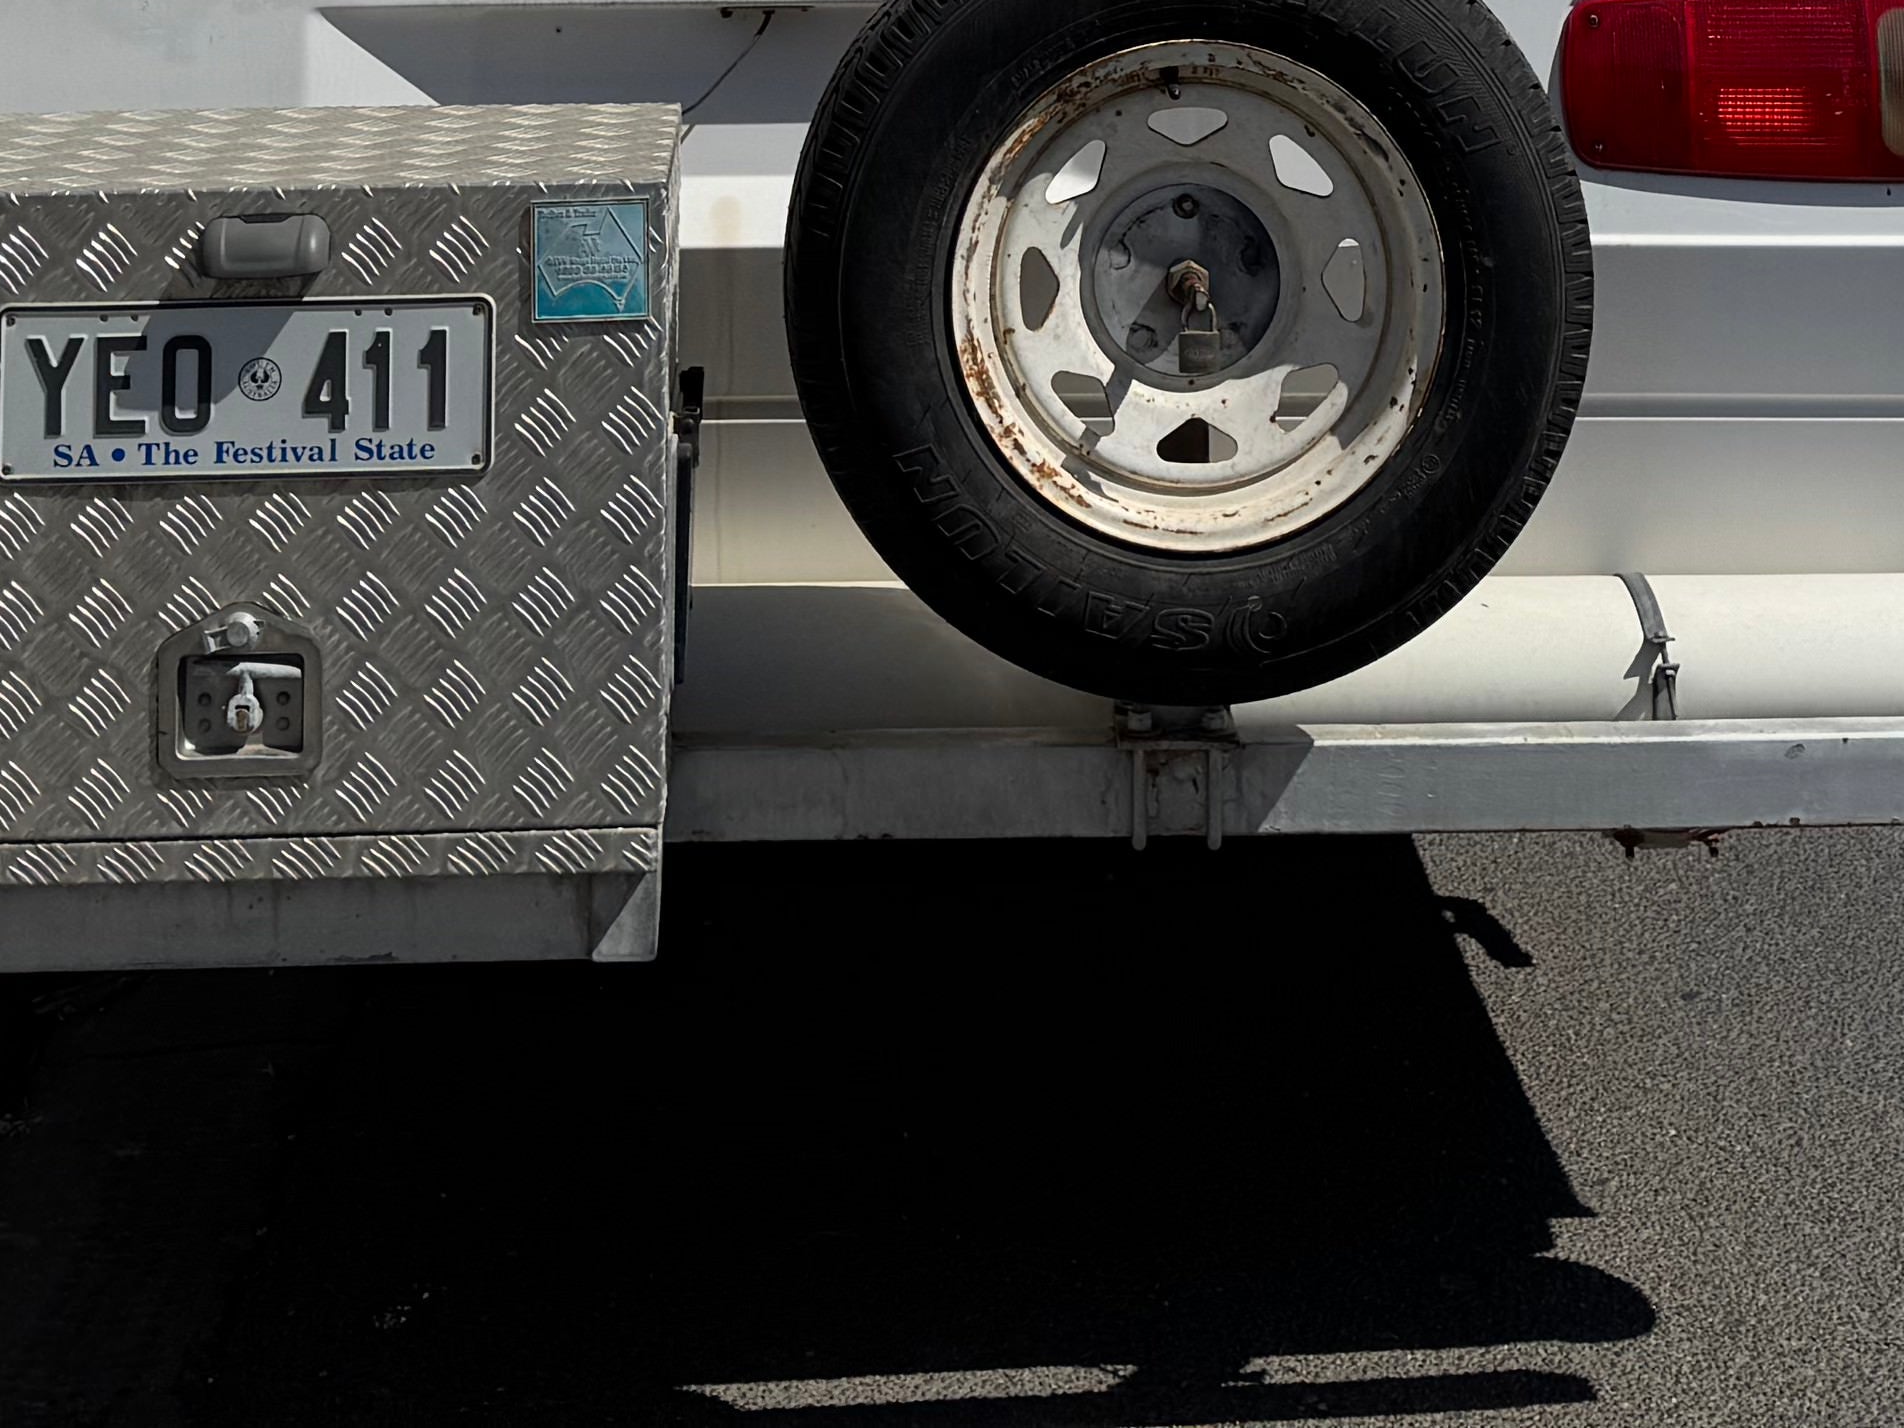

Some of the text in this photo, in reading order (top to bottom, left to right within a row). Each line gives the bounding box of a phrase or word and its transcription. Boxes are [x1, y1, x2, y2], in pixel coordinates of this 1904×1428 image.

[25, 326, 449, 438] YEO 411
[52, 436, 436, 469] SA The Festival State
